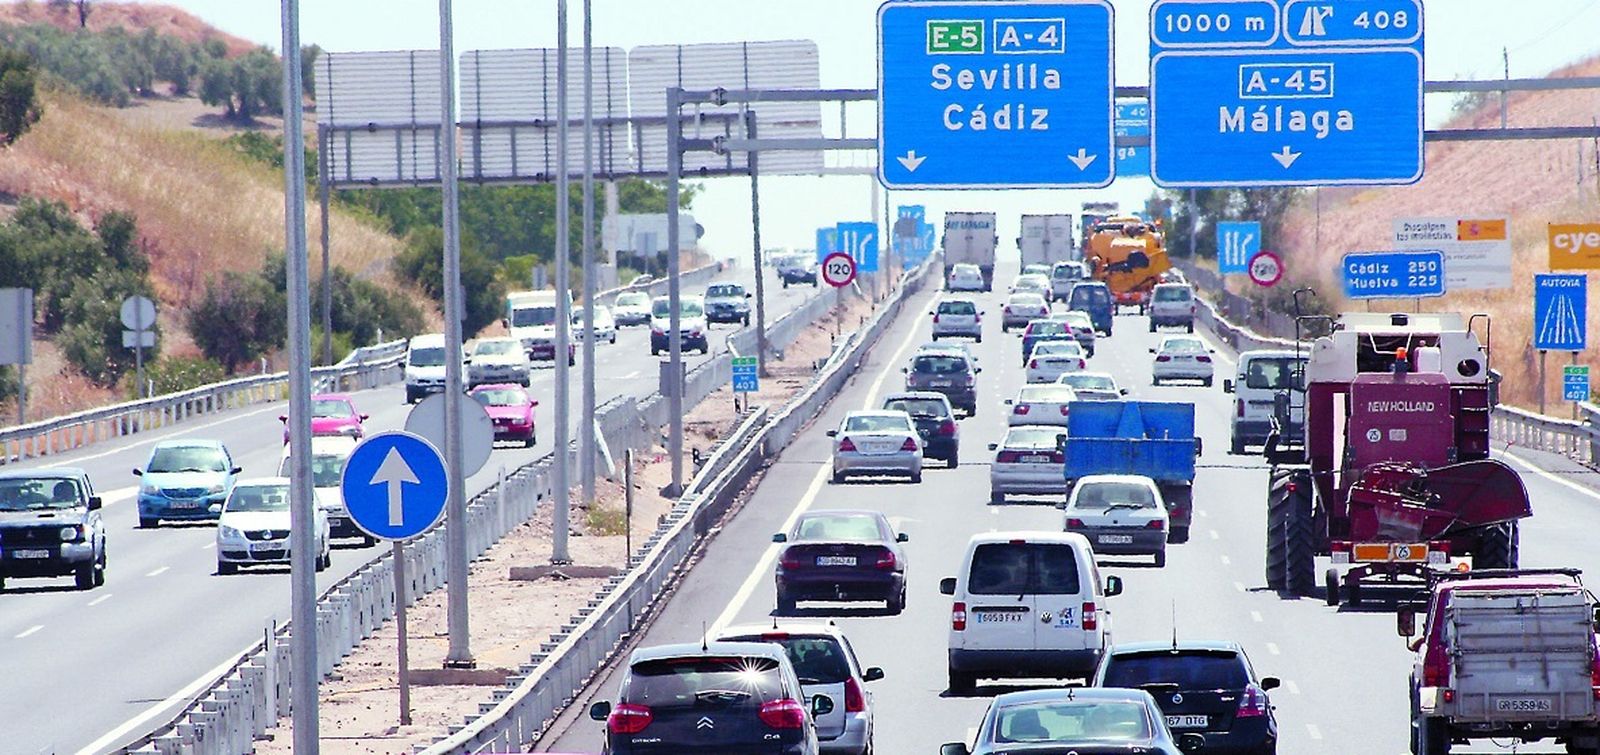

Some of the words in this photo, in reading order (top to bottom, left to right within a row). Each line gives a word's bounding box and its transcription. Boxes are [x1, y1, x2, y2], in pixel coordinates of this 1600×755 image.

[1165, 14, 1231, 33] 1000
[1245, 15, 1265, 31] m
[1353, 10, 1408, 29] 408
[932, 26, 978, 48] E-5
[1001, 26, 1058, 48] A-4
[931, 63, 1061, 90] Sevilla
[1246, 69, 1327, 93] A-45
[943, 103, 1049, 130] Cádiz
[1219, 105, 1354, 139] Málaga
[1554, 232, 1600, 254] cye
[828, 263, 850, 275] 120
[1349, 263, 1389, 275] Cádiz
[1408, 261, 1437, 273] 250
[1350, 277, 1398, 289] Huelva
[1408, 275, 1437, 287] 225
[736, 380, 755, 389] 407
[1566, 390, 1586, 400] 407
[1368, 401, 1389, 412] NEW
[1390, 401, 1435, 412] HOLLAND
